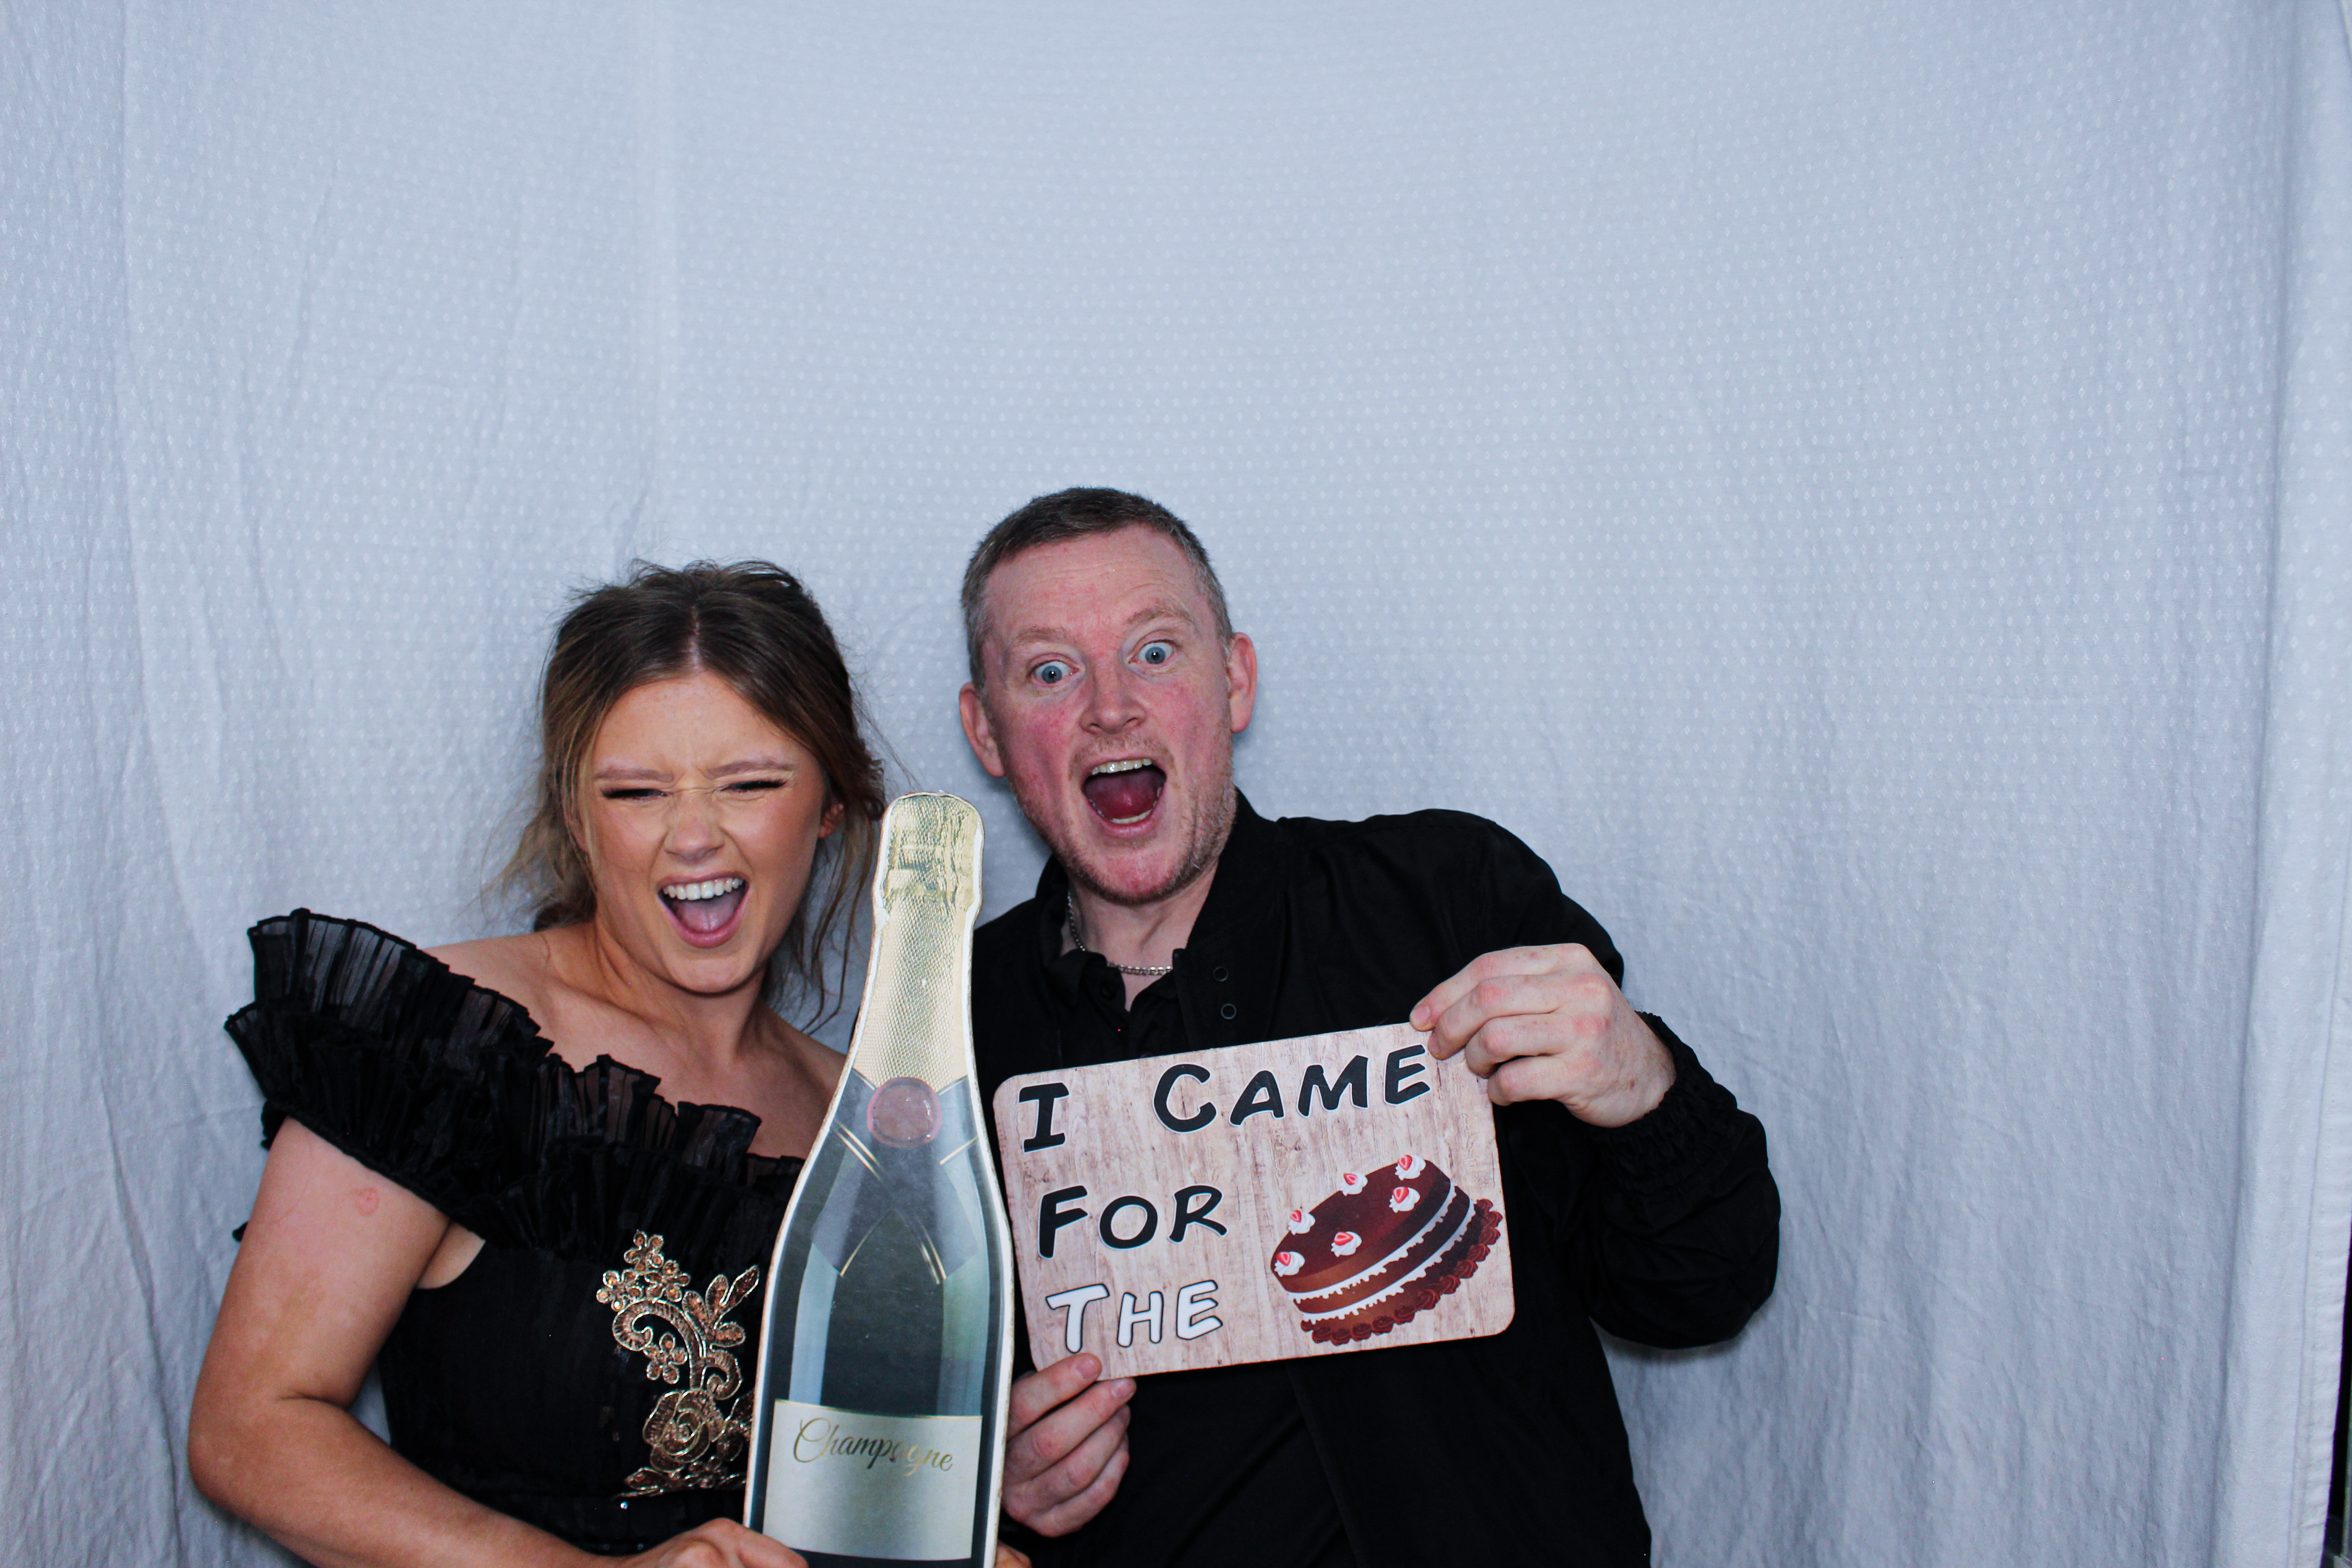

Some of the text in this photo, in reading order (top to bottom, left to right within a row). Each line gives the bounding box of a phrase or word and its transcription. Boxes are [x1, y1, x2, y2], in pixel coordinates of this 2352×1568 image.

[1019, 1044, 1431, 1153] I CAME
[1039, 1186, 1228, 1259] FOR
[1046, 1280, 1223, 1353] THE
[794, 1417, 952, 1476] Champagne
